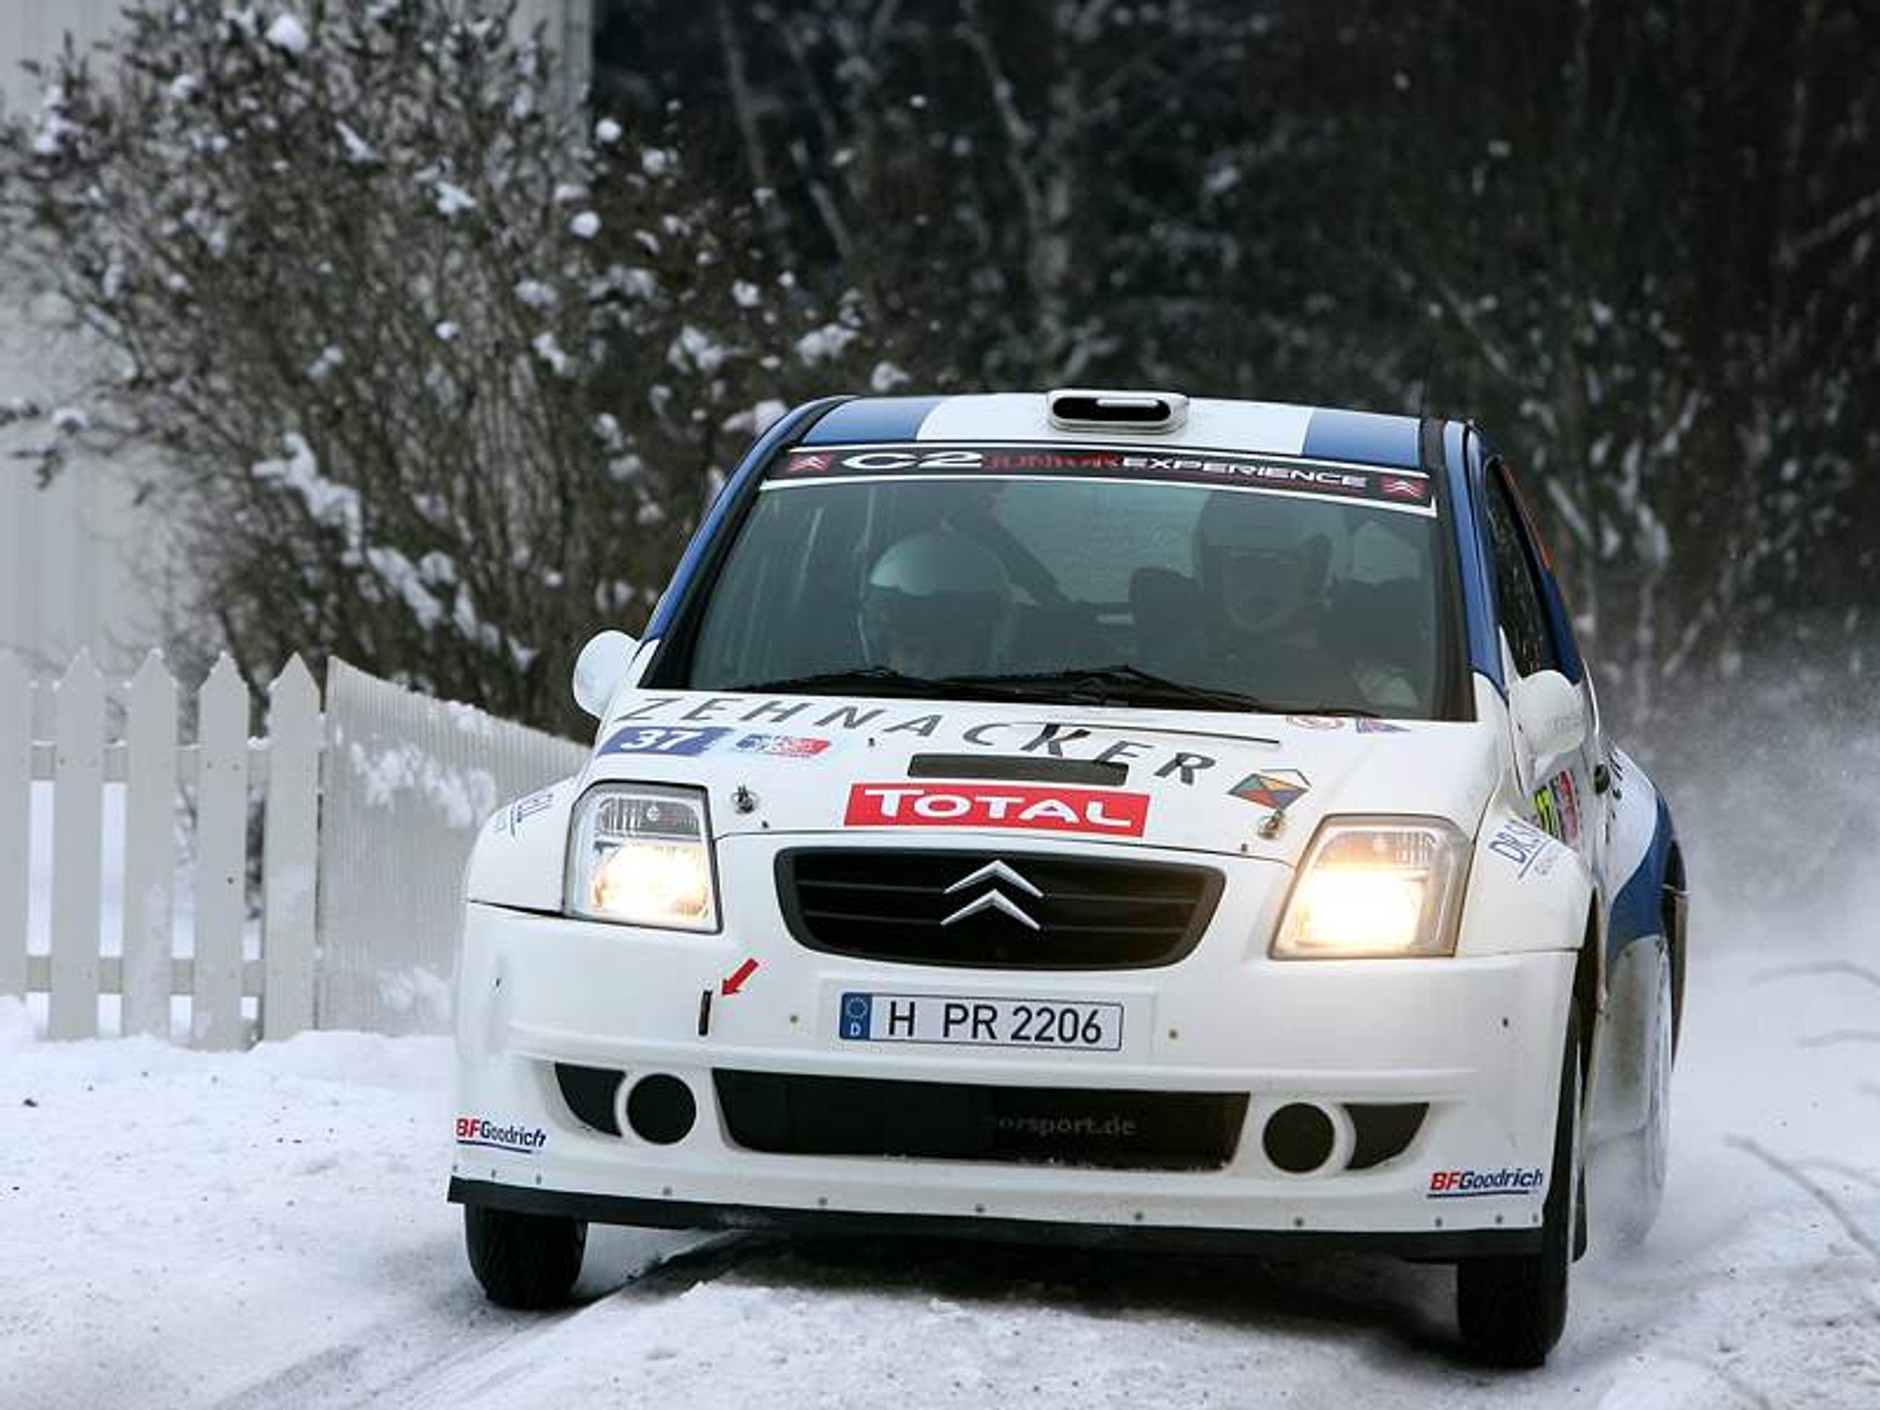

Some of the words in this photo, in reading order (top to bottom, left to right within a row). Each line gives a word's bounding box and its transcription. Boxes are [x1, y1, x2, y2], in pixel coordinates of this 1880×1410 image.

[841, 451, 983, 470] C2
[1122, 456, 1367, 488] EXPERIENCE
[614, 697, 1216, 785] ZEHNACKER
[619, 728, 706, 750] 37
[864, 788, 1133, 828] TOTAL
[849, 1022, 862, 1037] D
[888, 1001, 916, 1037] H
[943, 1003, 998, 1040] PR
[1010, 1006, 1103, 1044] 2206
[455, 1118, 547, 1148] BFGoodrich
[1429, 1167, 1544, 1191] BFGoodrich
